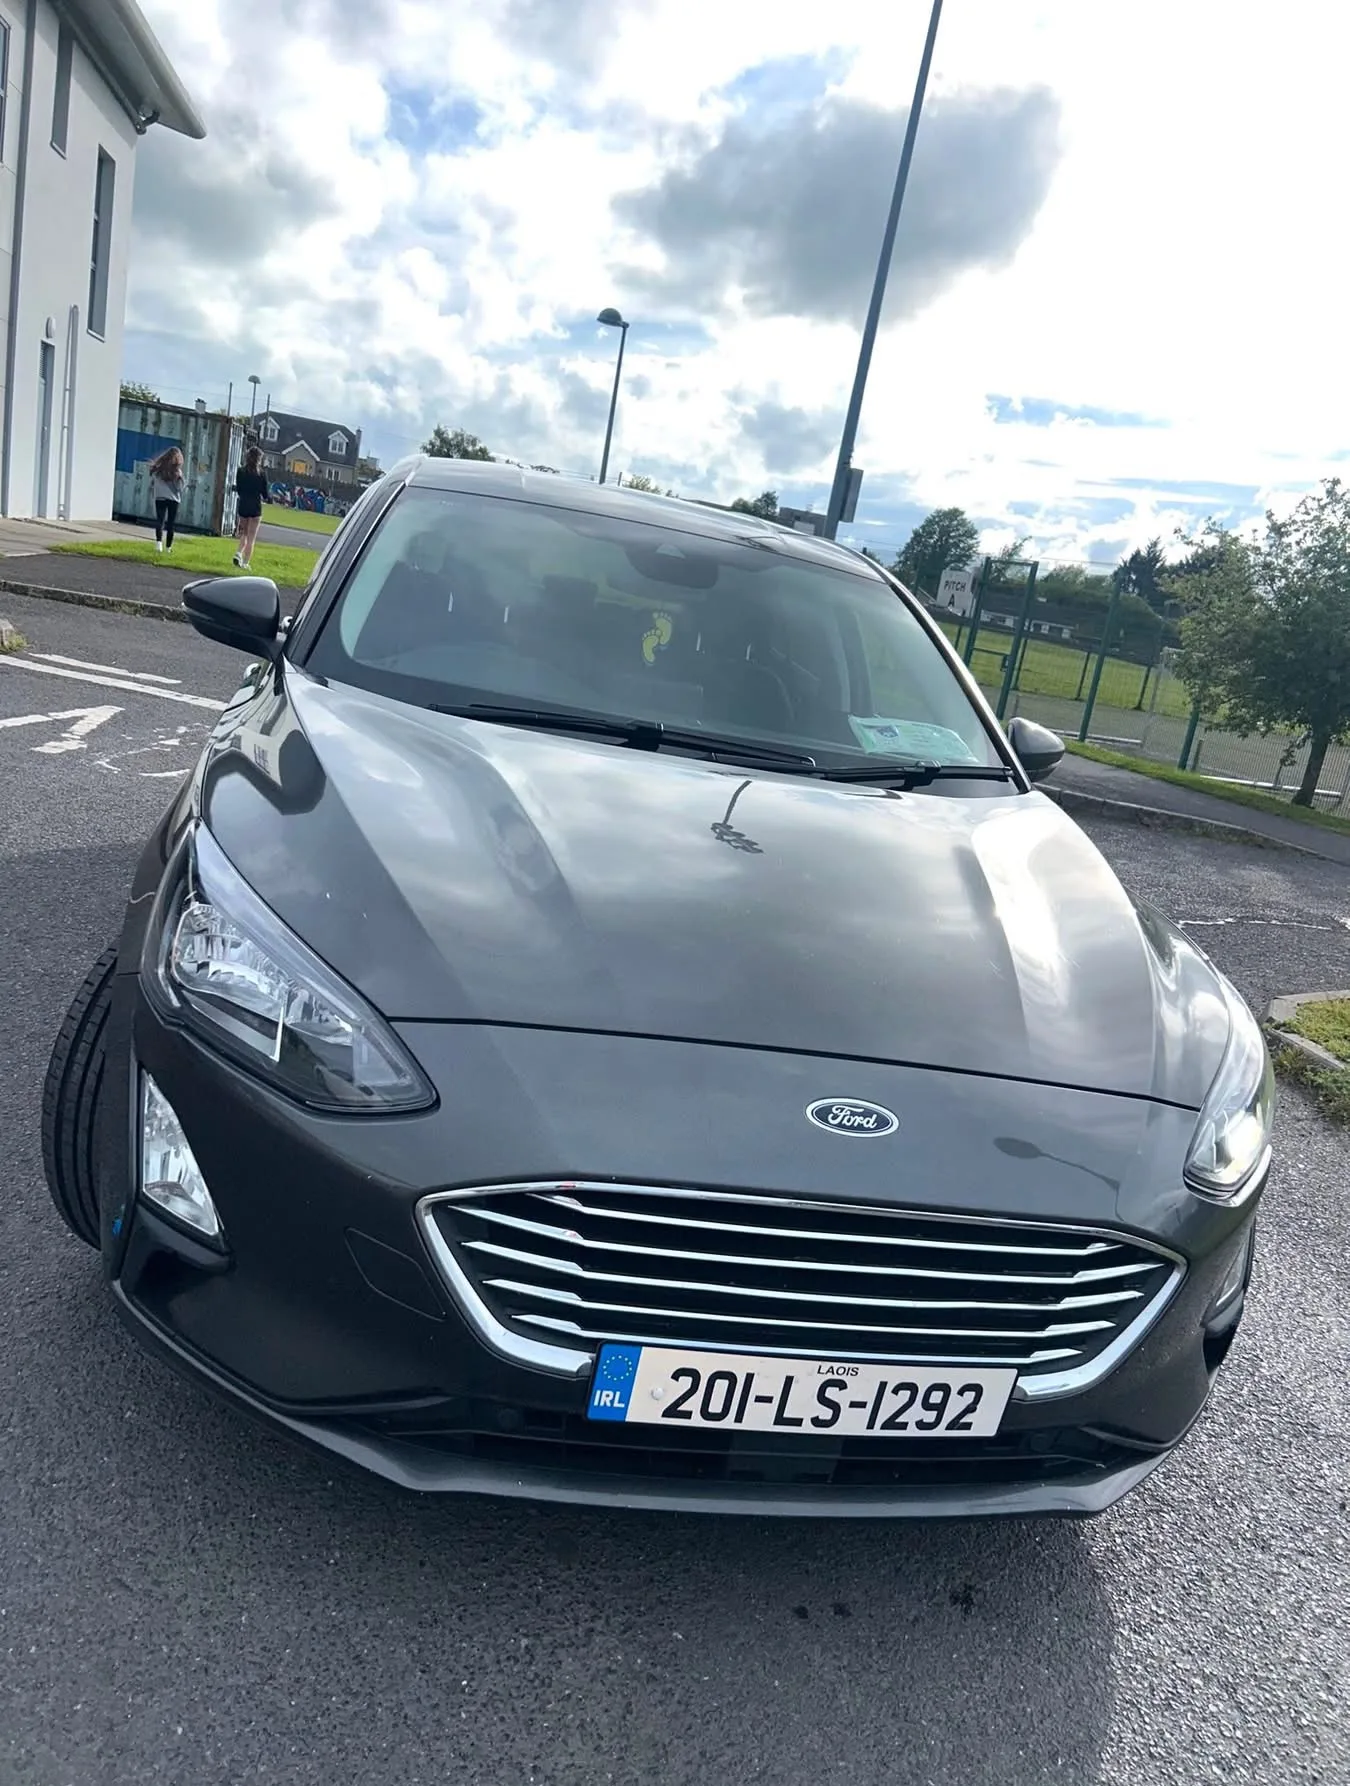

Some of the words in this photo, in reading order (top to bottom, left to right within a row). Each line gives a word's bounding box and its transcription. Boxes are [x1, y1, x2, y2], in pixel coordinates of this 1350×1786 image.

[943, 580, 967, 593] PITCH
[947, 593, 955, 607] A
[827, 1105, 878, 1129] Ford
[816, 1364, 860, 1377] LAOIS
[593, 1389, 625, 1408] IRL
[661, 1367, 984, 1431] 201-LS-1292
